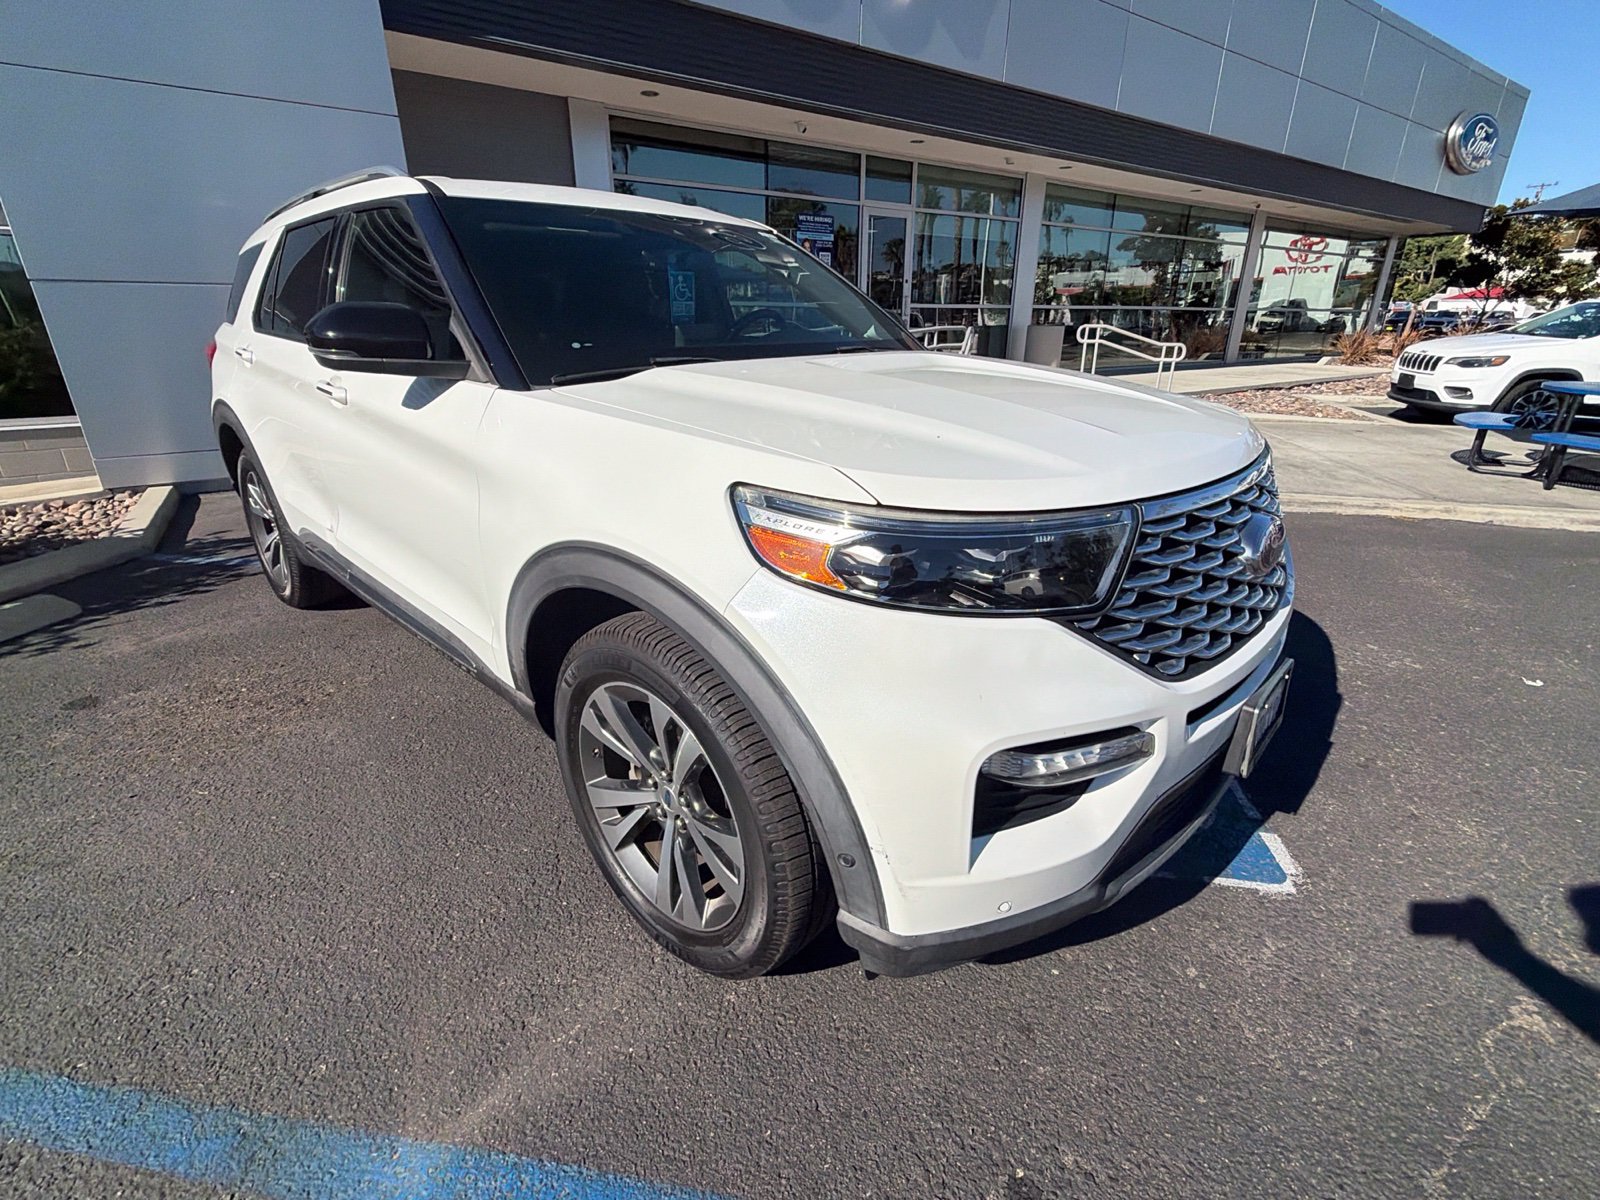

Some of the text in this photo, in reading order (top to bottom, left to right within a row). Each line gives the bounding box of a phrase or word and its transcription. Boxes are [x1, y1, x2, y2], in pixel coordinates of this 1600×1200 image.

[1467, 122, 1498, 158] Ford
[798, 214, 833, 224] WE'RE HIRING!
[754, 513, 838, 535] EXPLORE
